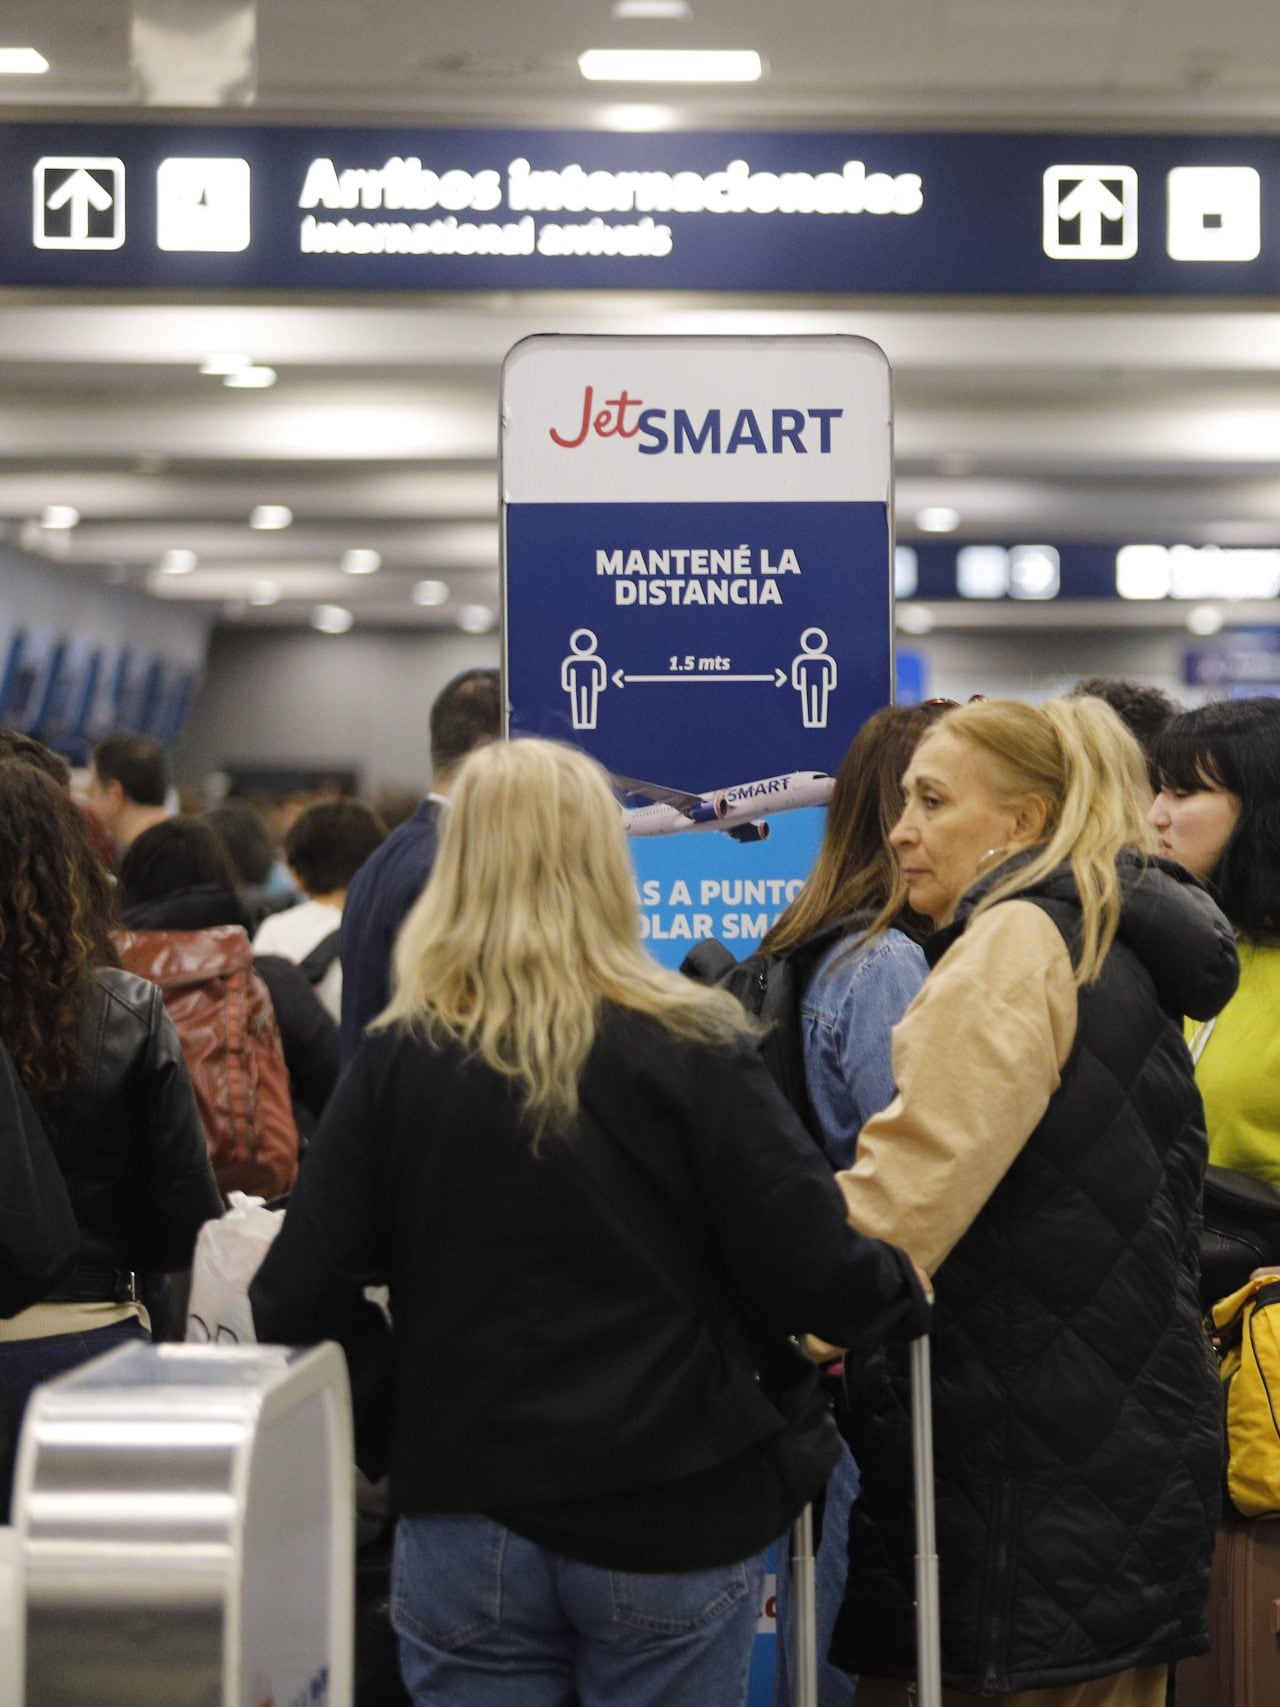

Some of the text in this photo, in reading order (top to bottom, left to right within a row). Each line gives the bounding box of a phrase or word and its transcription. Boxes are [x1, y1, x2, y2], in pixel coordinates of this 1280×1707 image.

[549, 385, 844, 455] JetSMART
[596, 544, 802, 576] MANTENÉ LA
[615, 579, 783, 606] DISTANCIA
[669, 656, 731, 671] 1.5 mts
[728, 777, 791, 802] SMART
[668, 880, 692, 906] A
[701, 879, 807, 906] PUNTO
